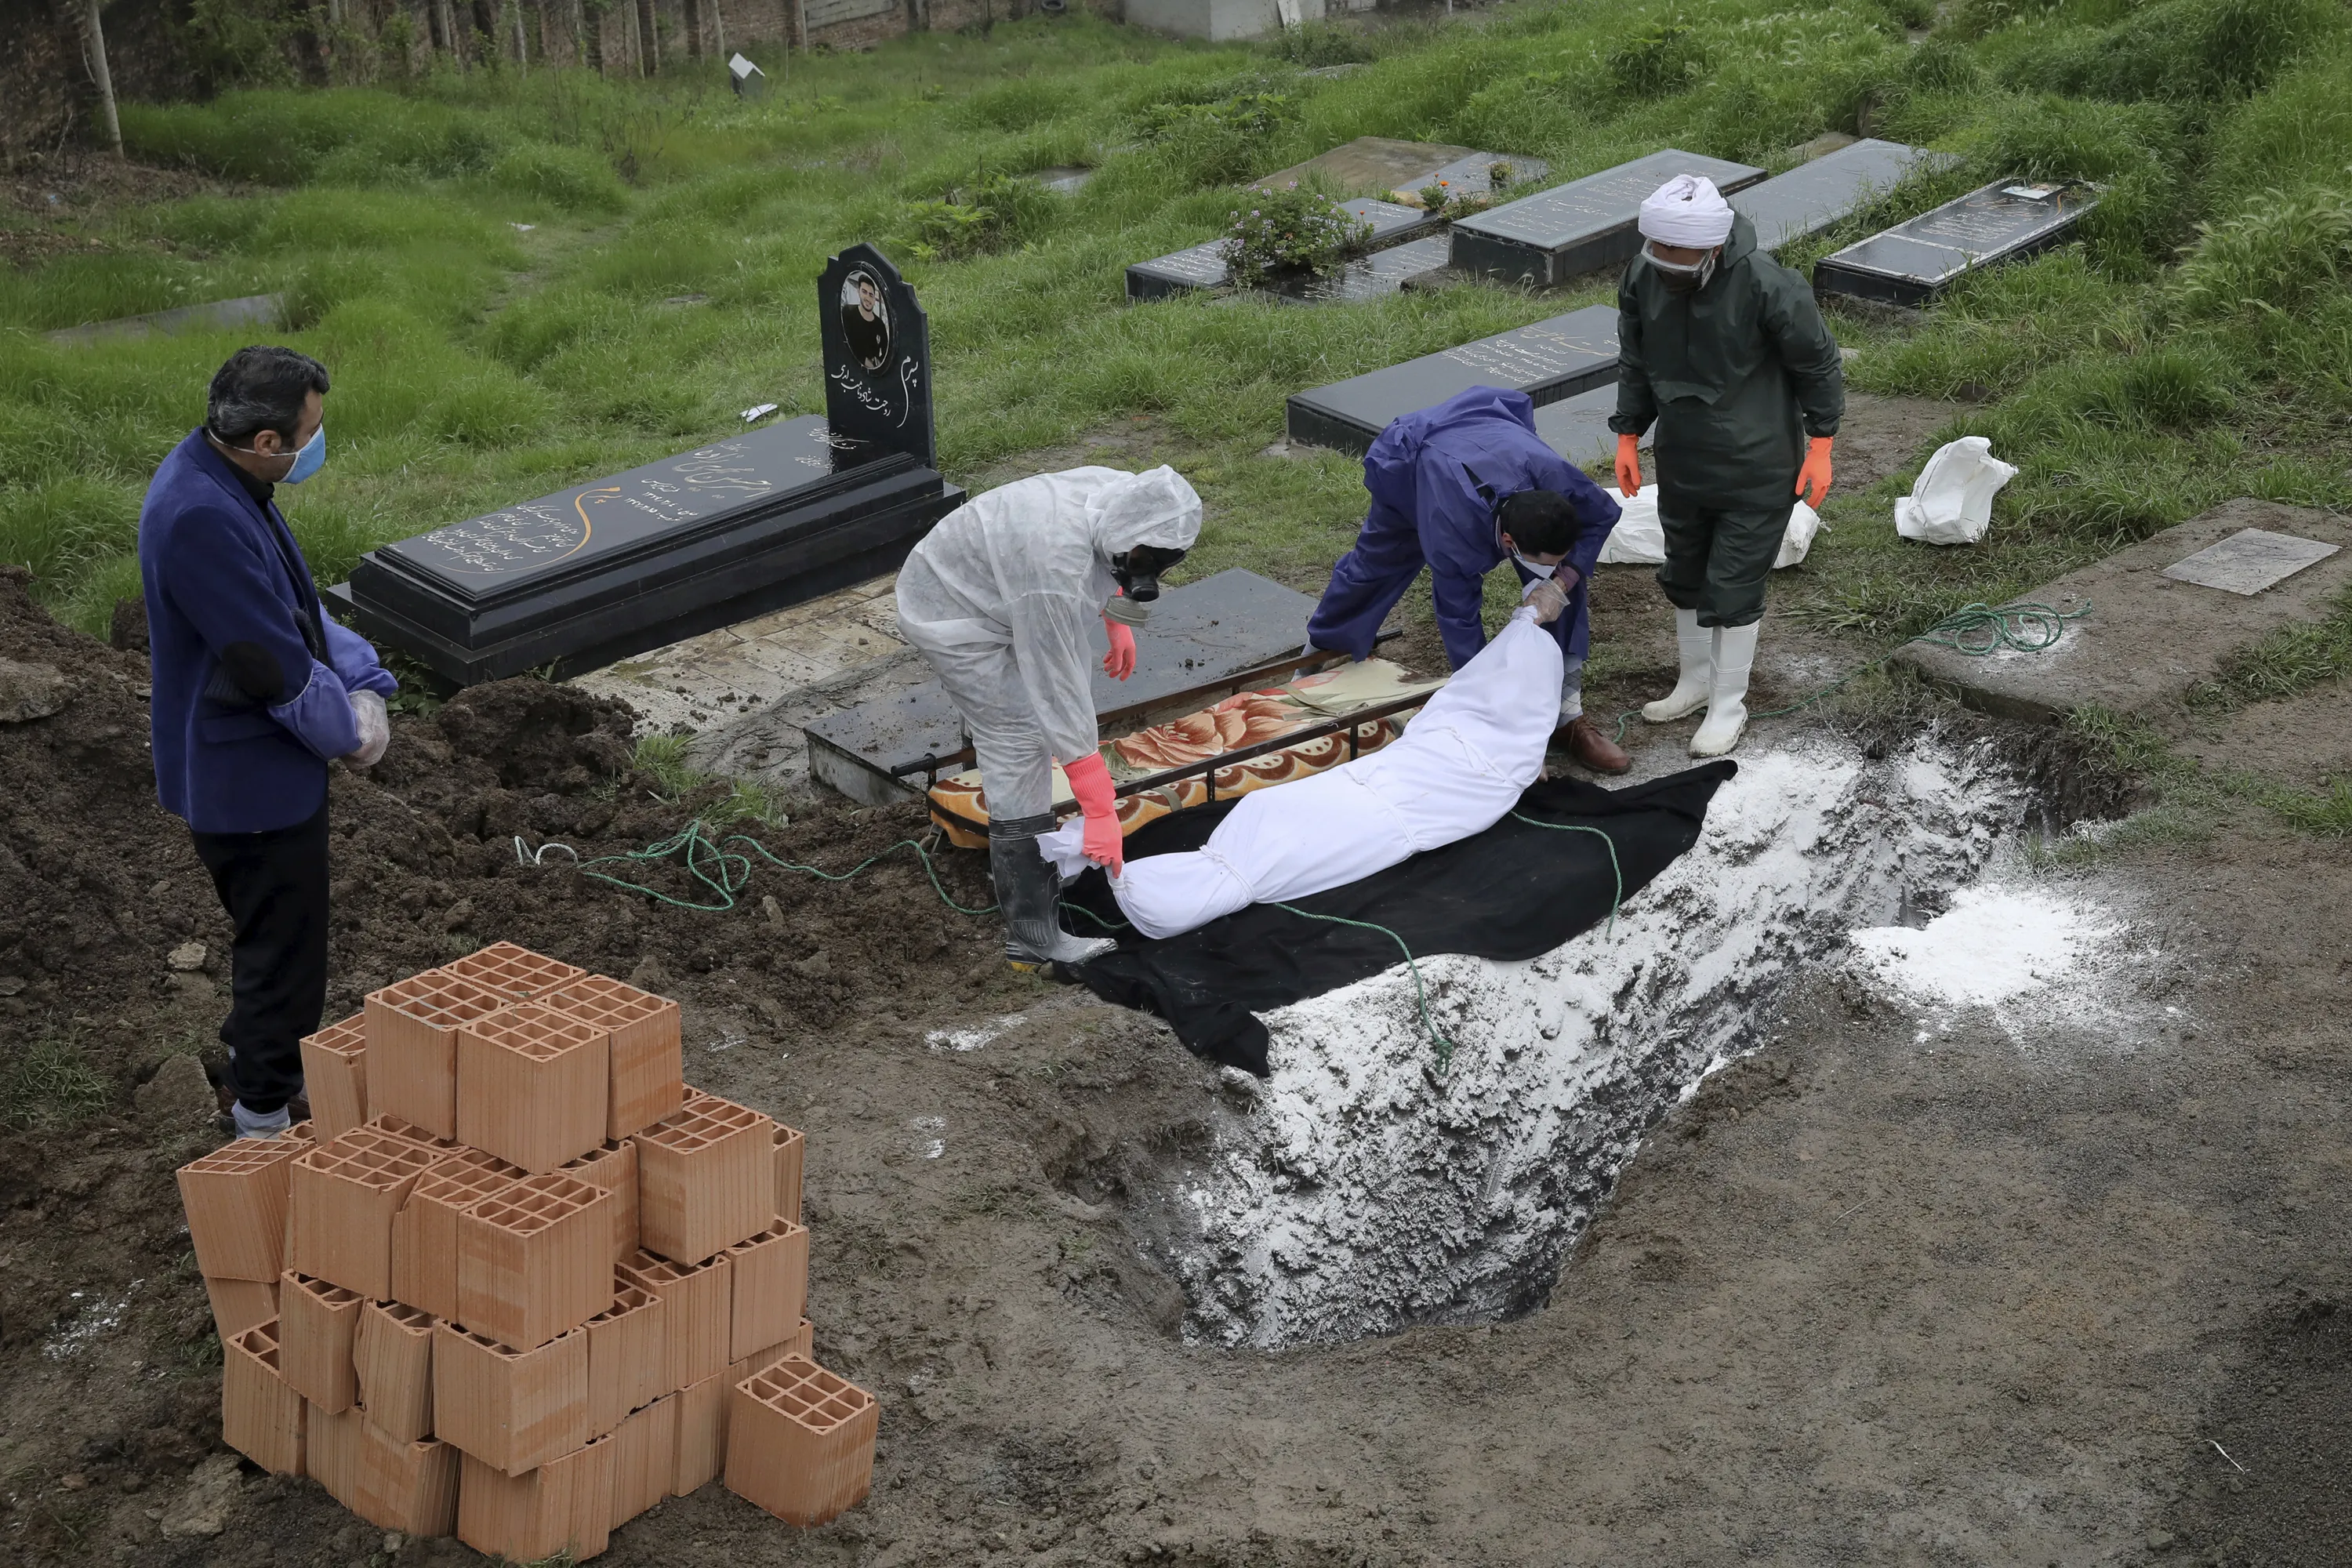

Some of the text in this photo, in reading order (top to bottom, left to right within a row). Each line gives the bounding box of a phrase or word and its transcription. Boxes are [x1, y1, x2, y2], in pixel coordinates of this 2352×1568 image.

[859, 387, 873, 403] شاد
[896, 355, 919, 429] پسرم
[865, 397, 891, 417] روحت
